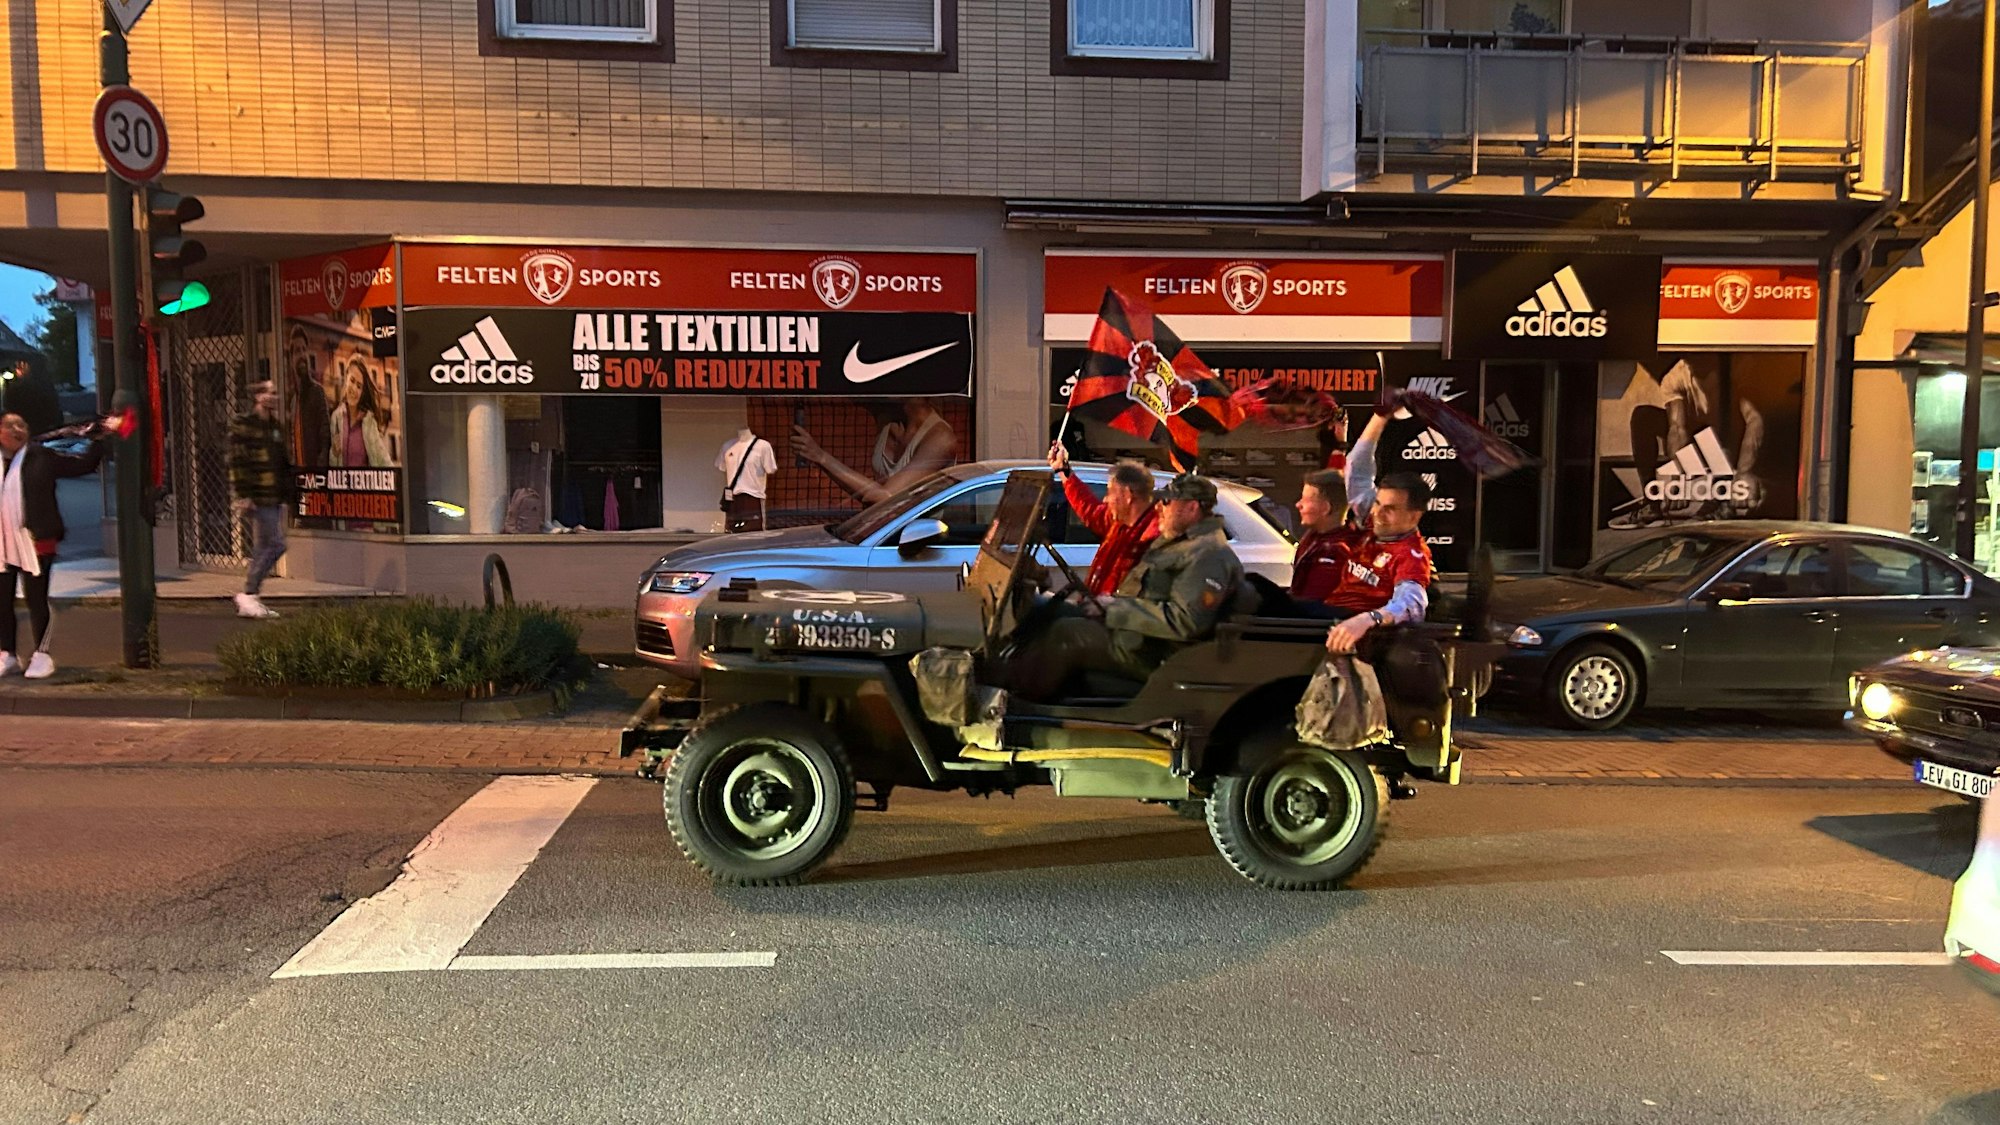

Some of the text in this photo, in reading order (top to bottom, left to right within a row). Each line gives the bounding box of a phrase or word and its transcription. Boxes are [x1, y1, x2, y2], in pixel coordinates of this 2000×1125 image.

[111, 111, 152, 157] 30
[284, 267, 393, 296] FELTEN SPORTS
[437, 266, 661, 288] FELTEN SPORTS
[730, 272, 943, 293] FELTEN SPORTS
[1144, 278, 1348, 296] FELTEN SPORTS
[1753, 285, 1812, 300] SPORTS
[572, 313, 820, 353] ALLE TEXTILIEN
[1505, 311, 1607, 337] adidas
[430, 360, 534, 384] adidas
[573, 354, 600, 371] BIS
[604, 358, 821, 389] 50% REDUZIERT
[580, 372, 600, 390] ZU
[1407, 377, 1454, 399] NIKE
[1401, 446, 1457, 460] adidas
[327, 470, 395, 491] ALLE TEXTILIEN
[1644, 474, 1750, 501] adidas
[333, 493, 396, 519] REDUZIERT
[1922, 764, 1944, 785] LEV
[1953, 772, 1967, 791] GI
